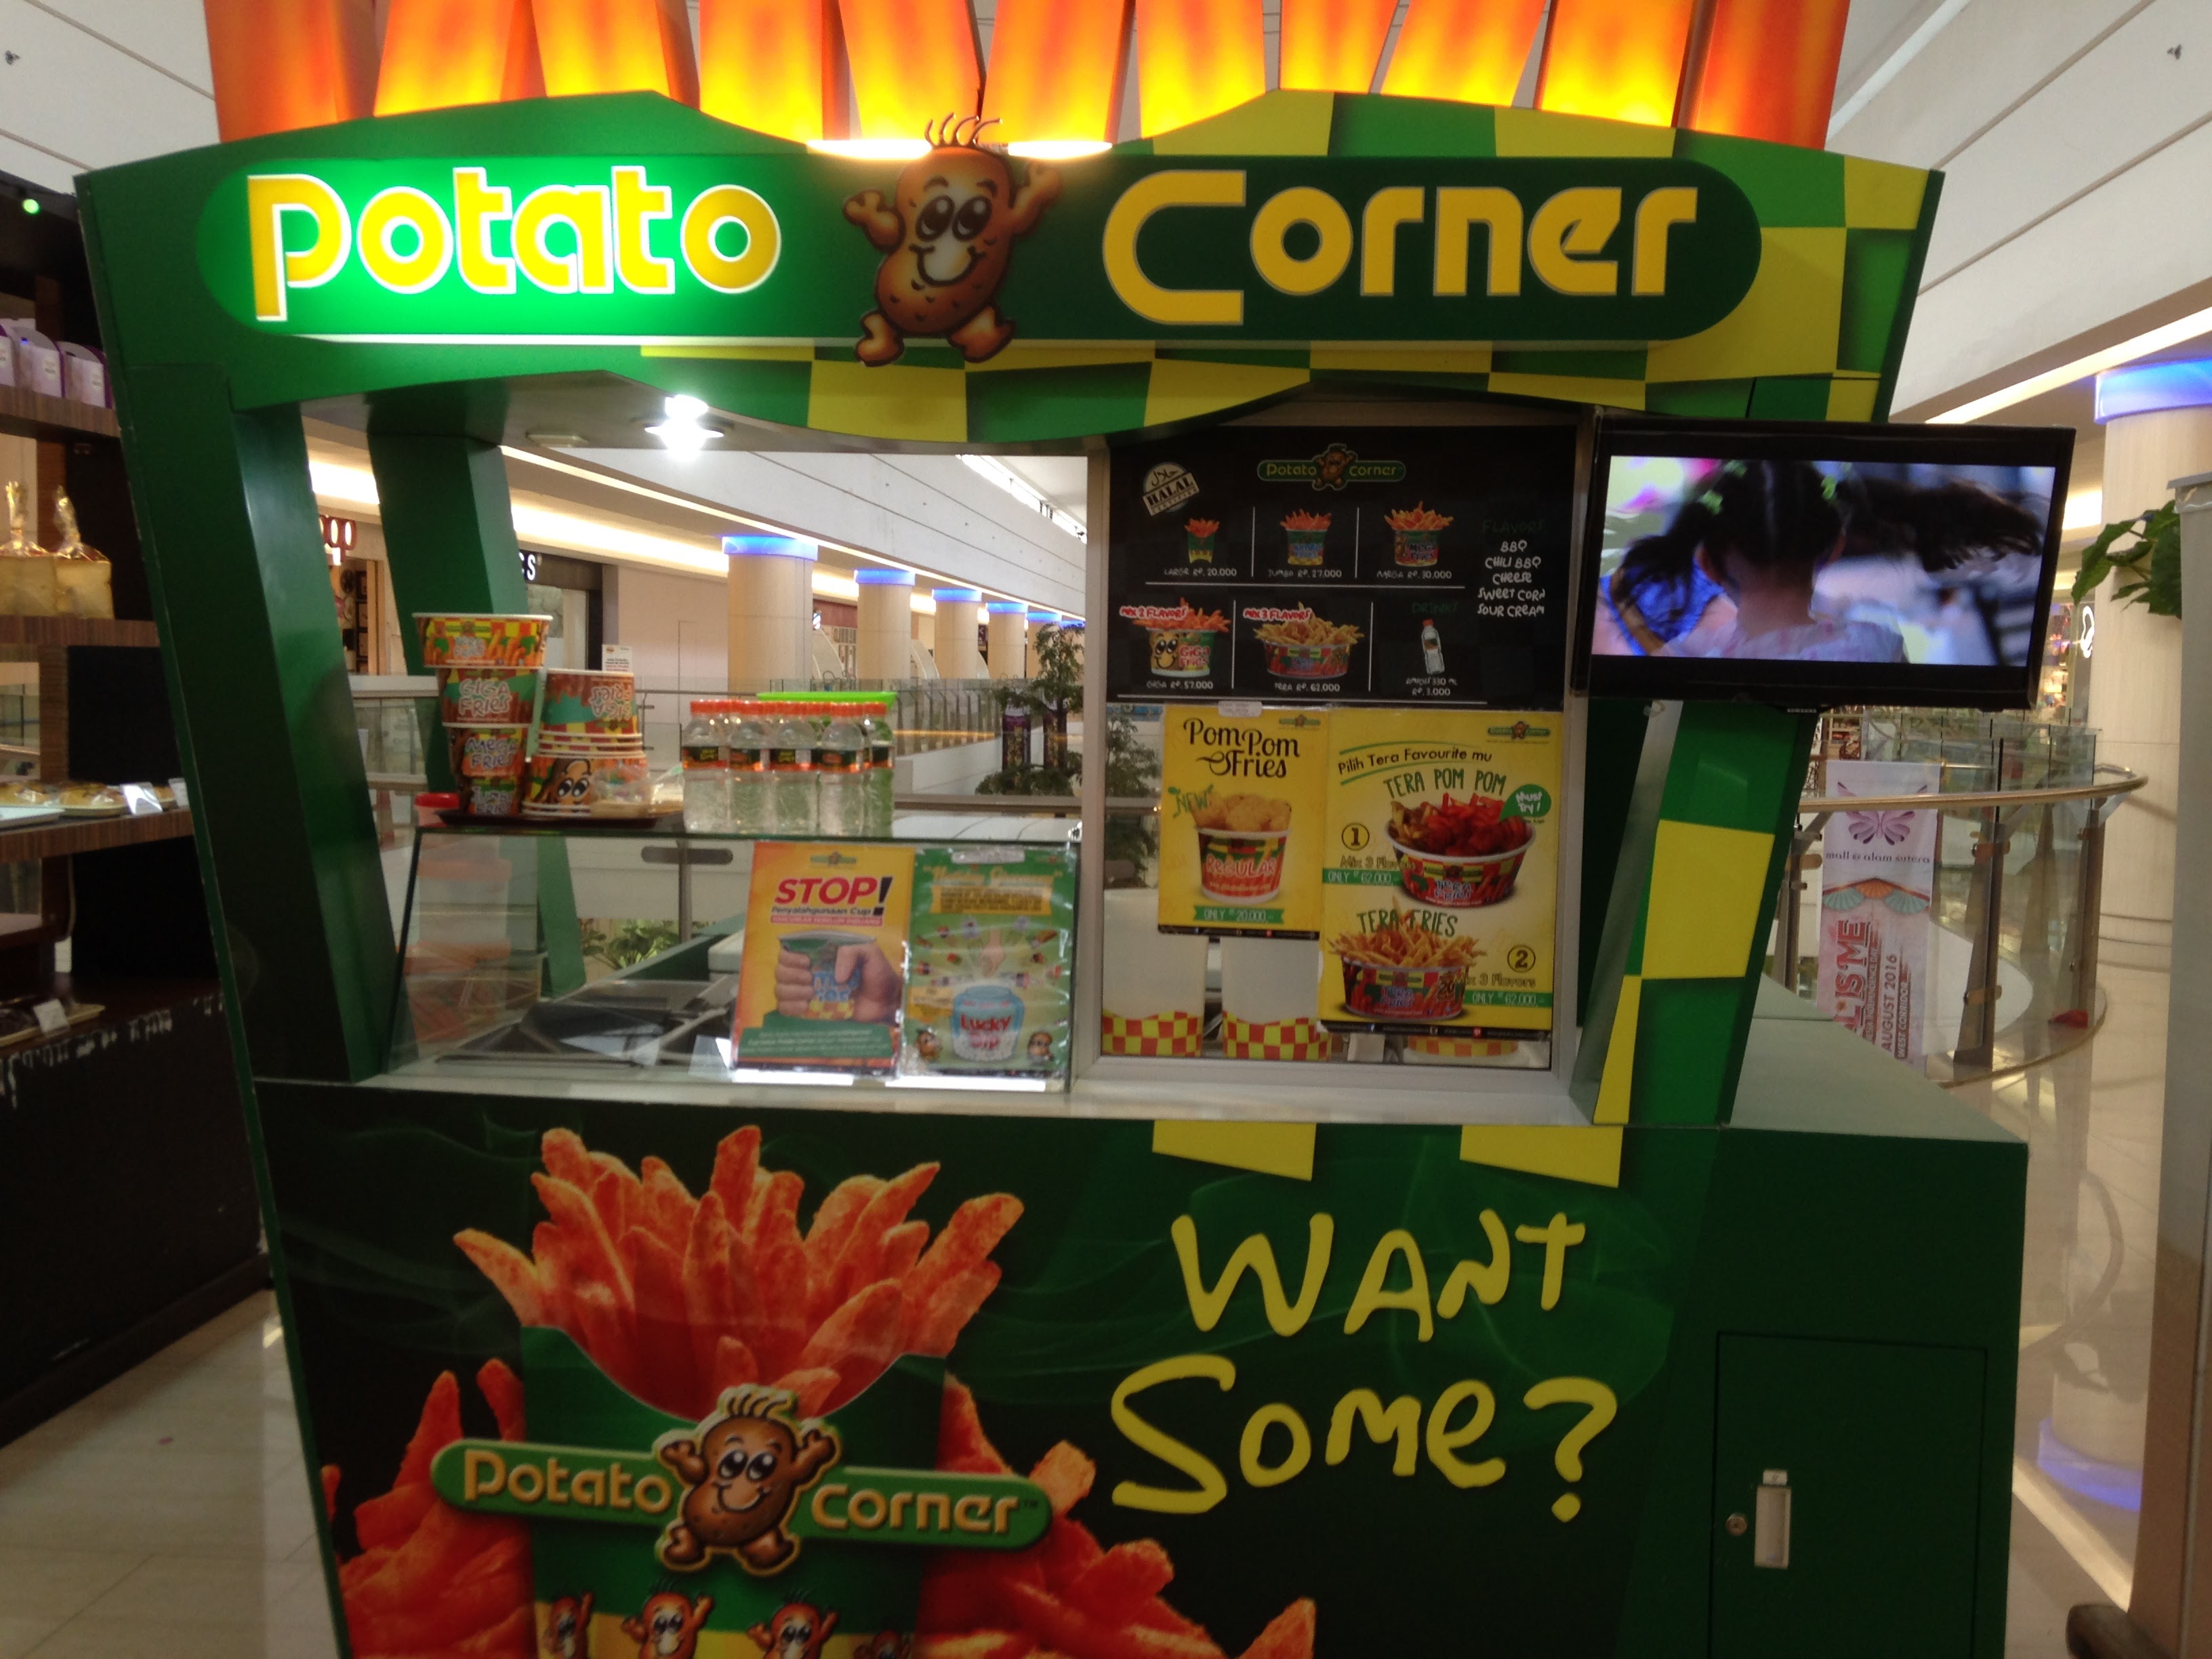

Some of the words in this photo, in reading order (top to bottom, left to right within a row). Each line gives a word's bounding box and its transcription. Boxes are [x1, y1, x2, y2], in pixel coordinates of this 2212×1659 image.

[247, 166, 781, 321] Potato
[1103, 170, 1698, 325] Corner
[1267, 464, 1317, 477] Potato
[1145, 477, 1195, 507] HALAL
[1500, 539, 1528, 552] BBQ
[1485, 556, 1512, 569] CHILI
[1514, 556, 1542, 569] BBQ
[1207, 569, 1237, 577] 20.000
[1477, 586, 1515, 600] SWEET
[1517, 588, 1545, 601] CORN
[1139, 608, 1145, 617] 2
[1147, 607, 1188, 619] FLAVORS
[1261, 609, 1267, 619] 3
[1269, 608, 1312, 621] FLAVORS
[1477, 602, 1504, 616] SOUR
[1507, 602, 1545, 617] CREAM
[459, 678, 510, 696] GIGA
[1184, 681, 1214, 690] 57.000
[1310, 683, 1340, 692] 62.000
[1183, 717, 1242, 746] Pom
[1241, 729, 1300, 758] Pom
[1198, 750, 1287, 778] Fries
[1338, 757, 1364, 775] Pilih
[1367, 751, 1399, 766] Tera
[1404, 747, 1468, 762] Favourite
[1471, 752, 1493, 762] mu
[1382, 771, 1425, 799] TERA
[1434, 768, 1465, 790] POM
[1477, 769, 1507, 796] POM
[1365, 856, 1374, 868] 3
[1864, 852, 1892, 862] alam
[1895, 855, 1930, 864] sutera
[774, 875, 893, 916] STOP!
[1356, 909, 1399, 935] TERA
[1409, 909, 1458, 938] FRIES
[1883, 954, 1898, 989] 2016
[1480, 975, 1489, 987] 3
[1881, 994, 1896, 1052] AUGUST
[464, 1448, 674, 1515] Potato
